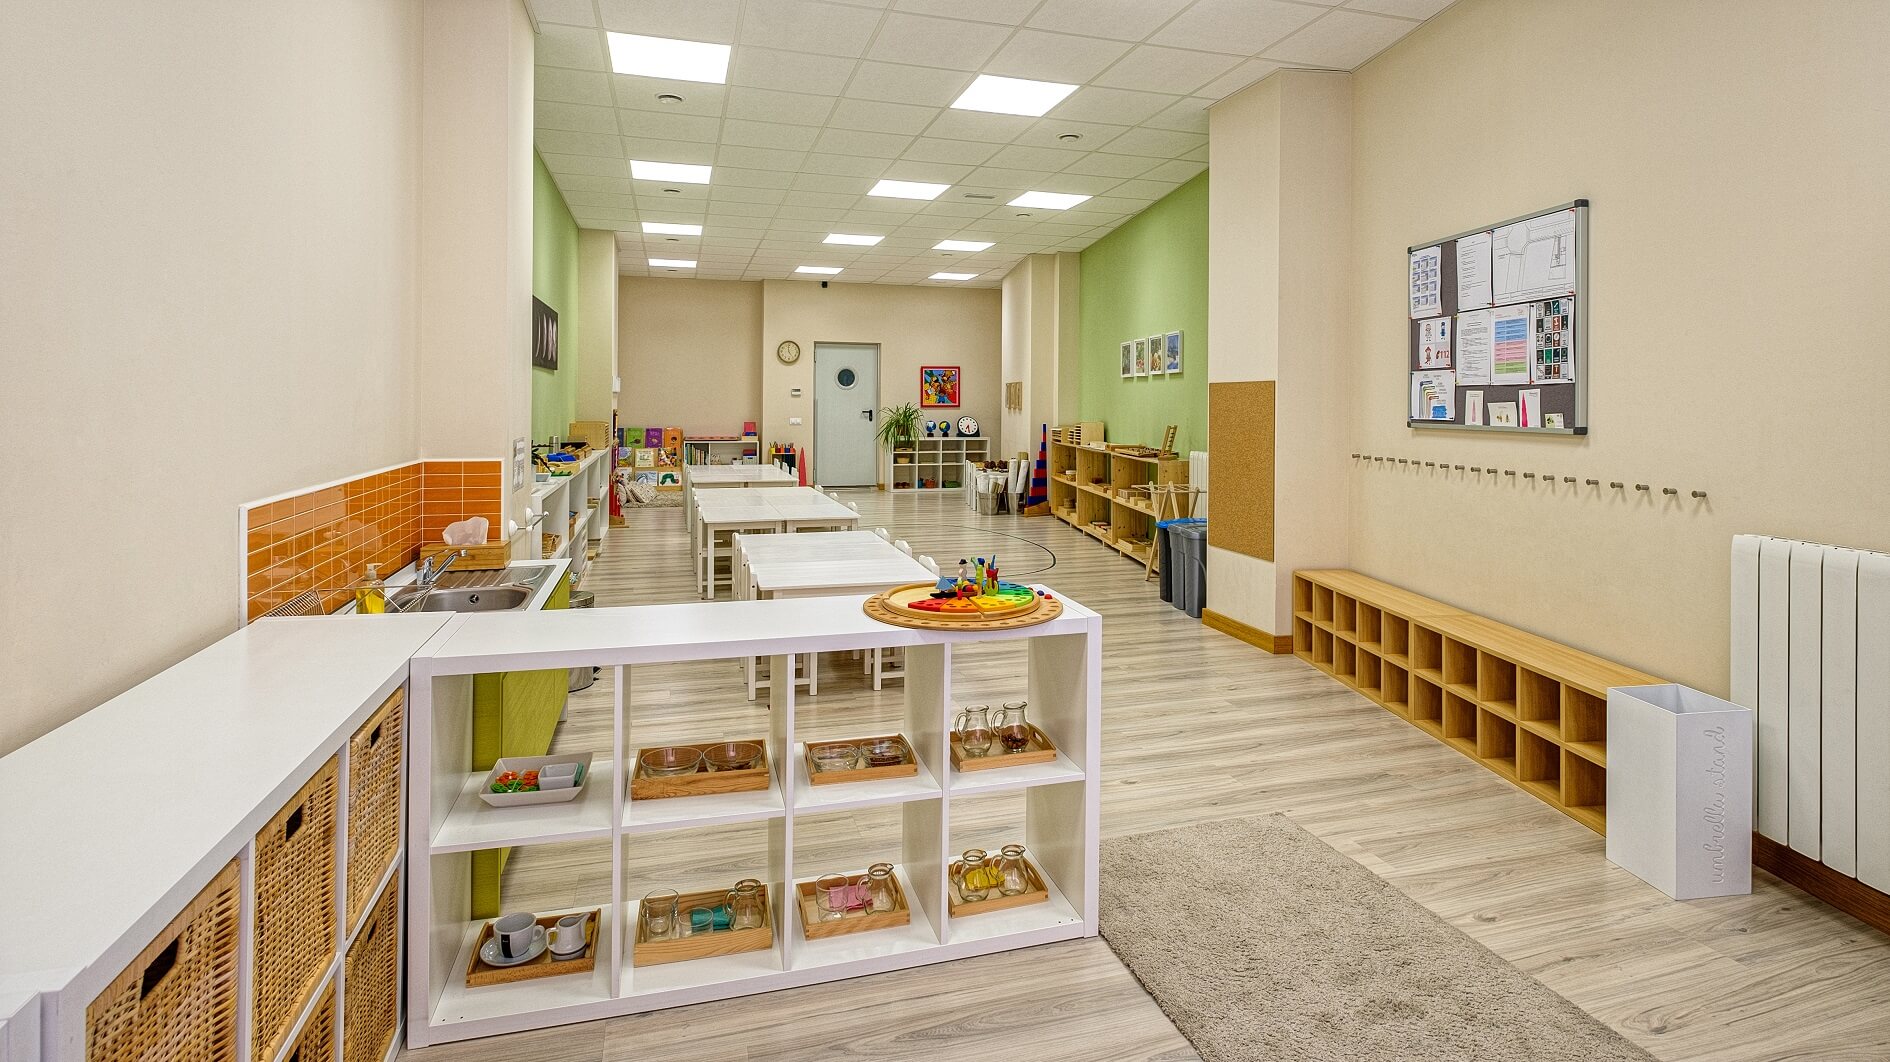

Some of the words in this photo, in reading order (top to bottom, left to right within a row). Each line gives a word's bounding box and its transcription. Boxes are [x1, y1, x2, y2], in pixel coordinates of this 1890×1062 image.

[1440, 350, 1449, 359] 112
[1703, 726, 1726, 788] stand
[1703, 792, 1726, 884] umbrella
